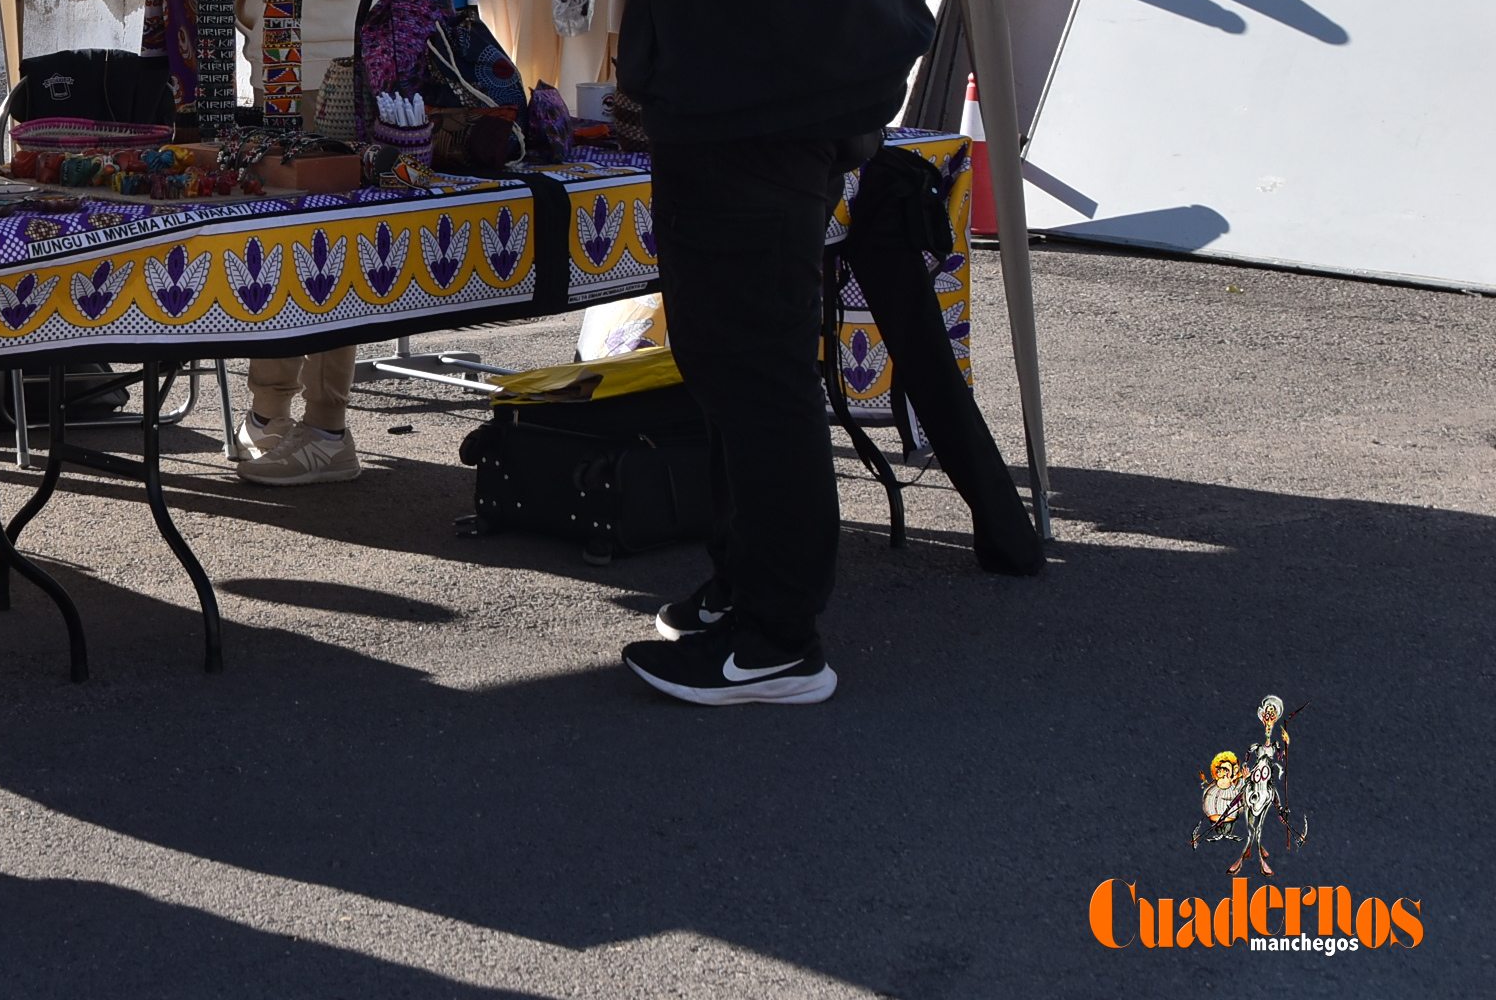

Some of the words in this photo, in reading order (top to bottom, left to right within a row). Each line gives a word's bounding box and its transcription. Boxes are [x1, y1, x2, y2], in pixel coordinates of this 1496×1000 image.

[31, 237, 83, 257] MUNGU
[87, 233, 100, 246] NI
[104, 220, 159, 241] MWEMA
[162, 212, 194, 227] KILA
[197, 204, 249, 219] WAKATI
